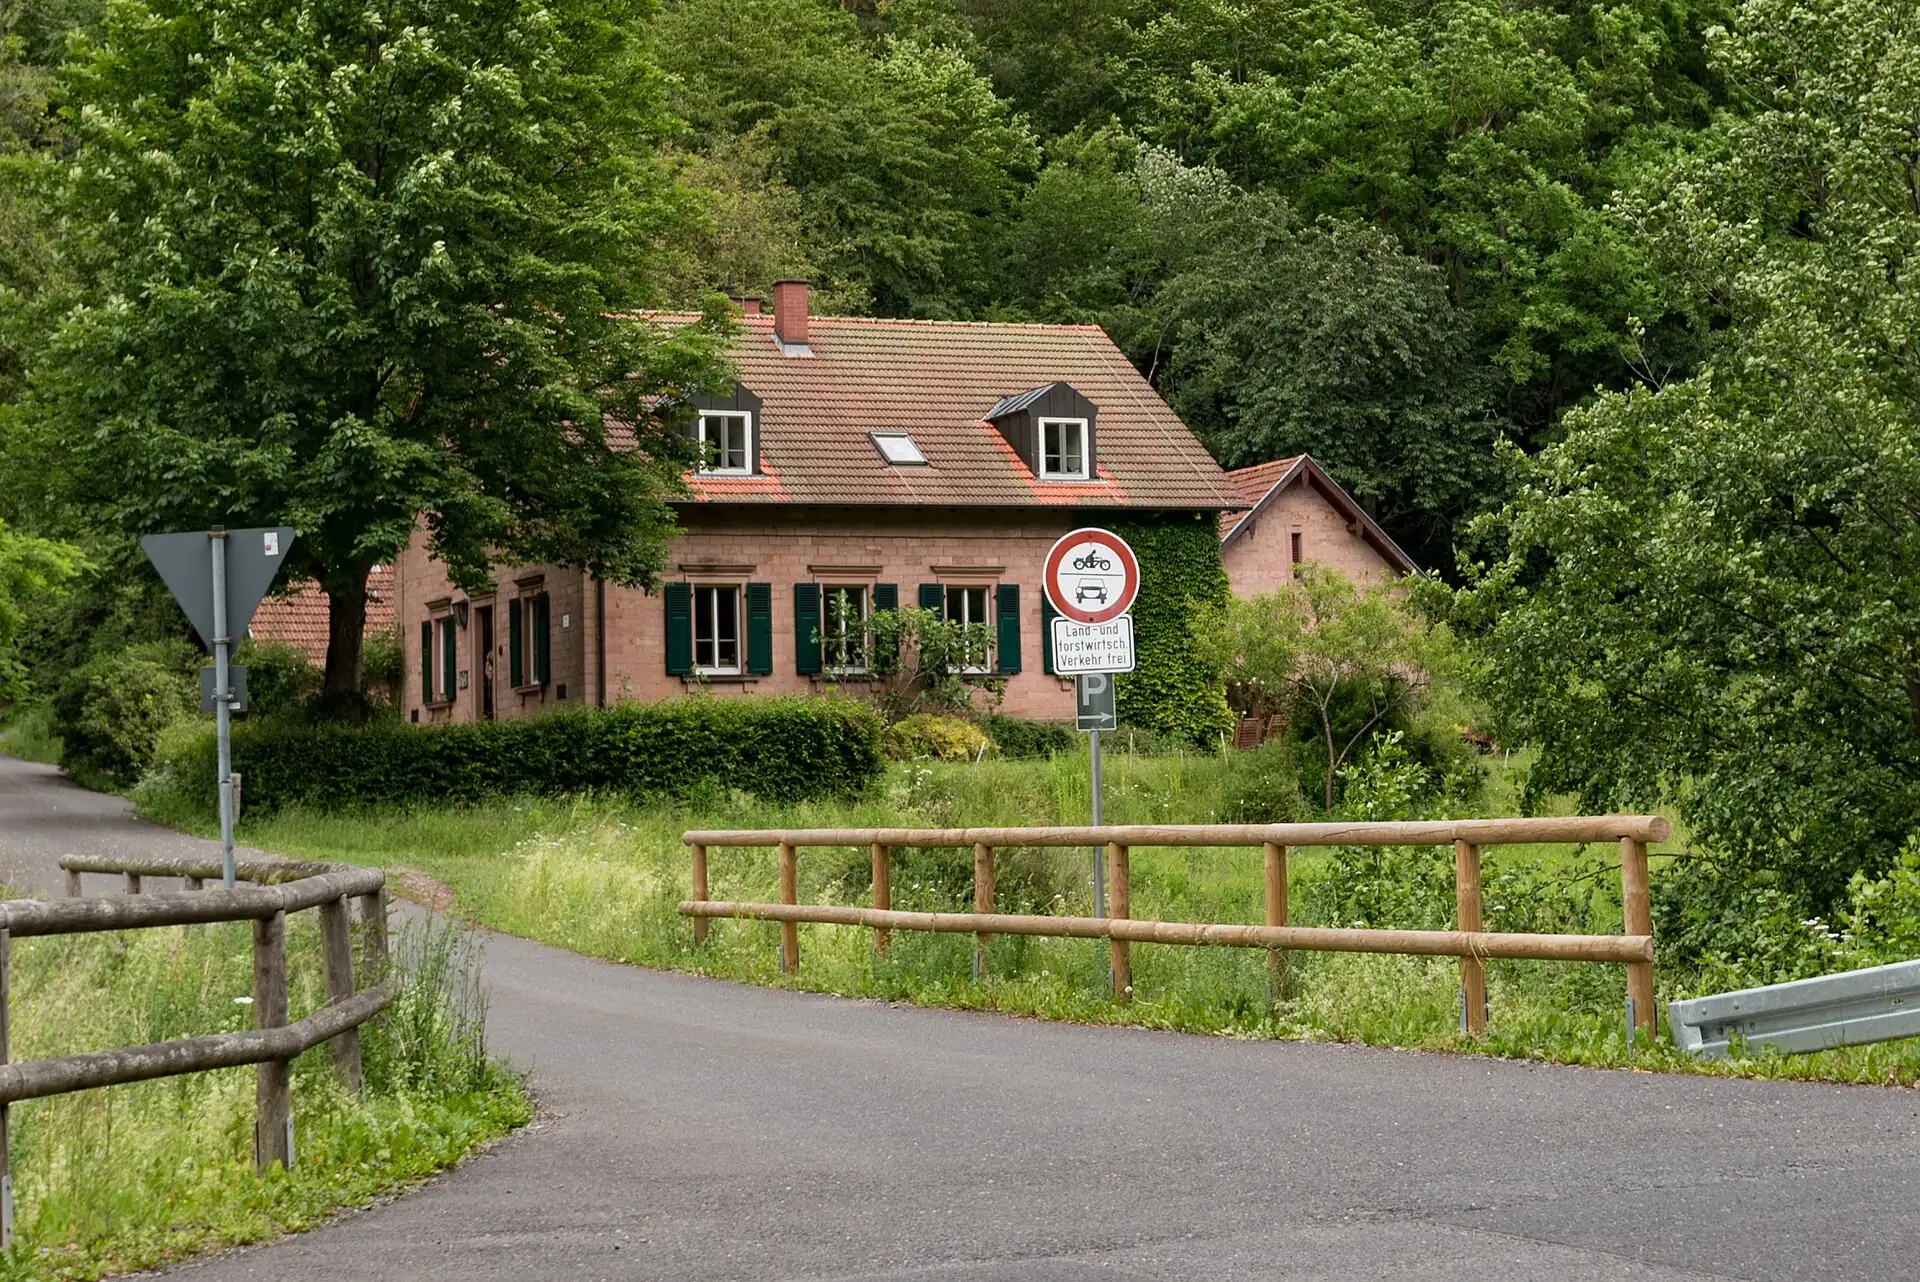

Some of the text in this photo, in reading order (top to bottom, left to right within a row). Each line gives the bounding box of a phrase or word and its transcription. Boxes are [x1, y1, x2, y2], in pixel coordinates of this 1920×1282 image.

[1059, 637, 1128, 652] forstwirtsch.
[1060, 652, 1126, 666] Verkehr frei
[1081, 673, 1107, 706] P
